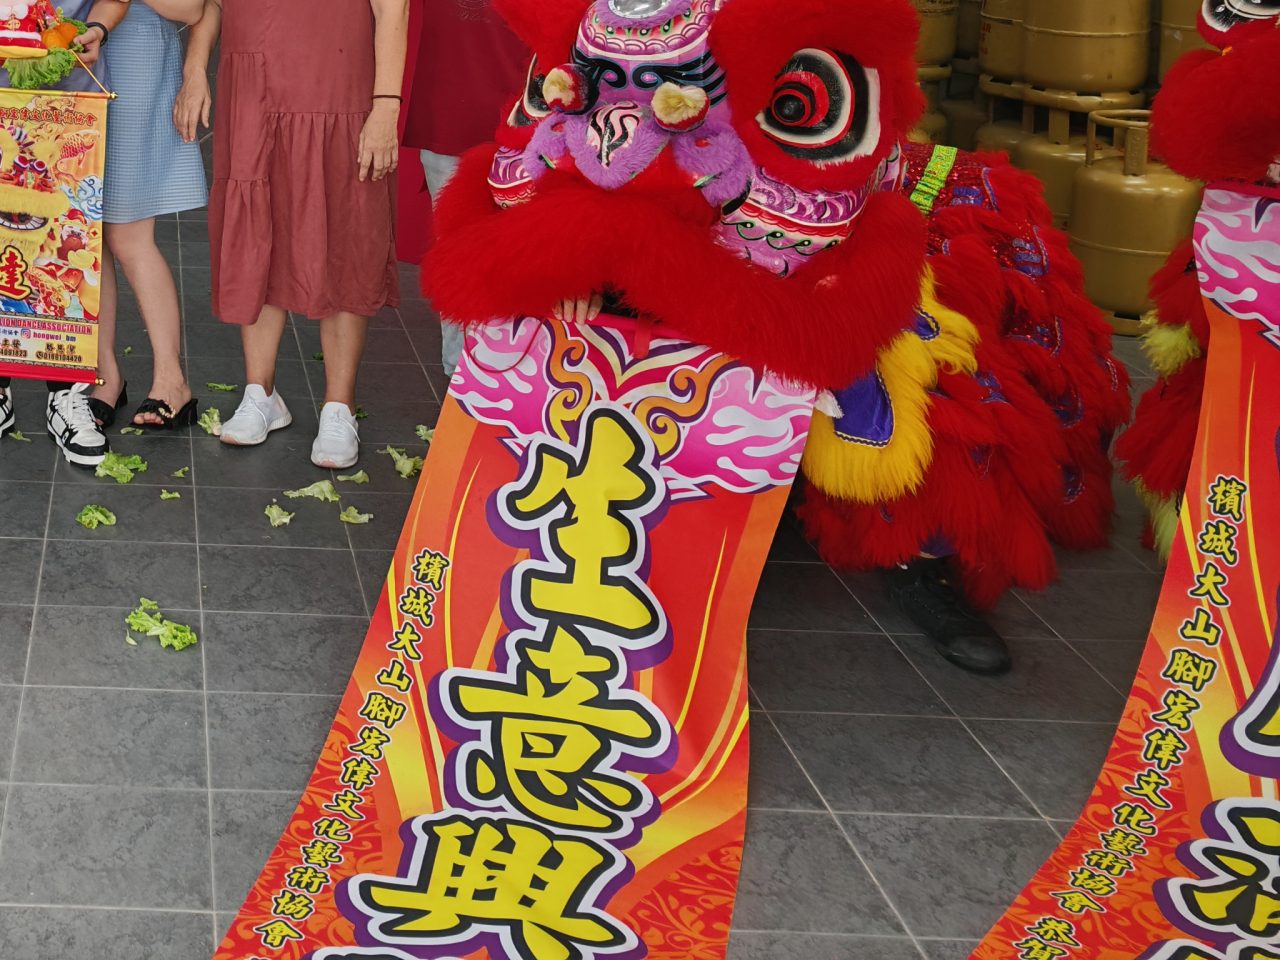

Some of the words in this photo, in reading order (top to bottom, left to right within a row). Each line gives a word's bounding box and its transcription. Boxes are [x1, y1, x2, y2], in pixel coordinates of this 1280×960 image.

[0, 317, 17, 327] LION
[18, 319, 41, 329] DANCE
[41, 321, 92, 334] ASSOCIATION
[358, 408, 658, 960] 生意興
